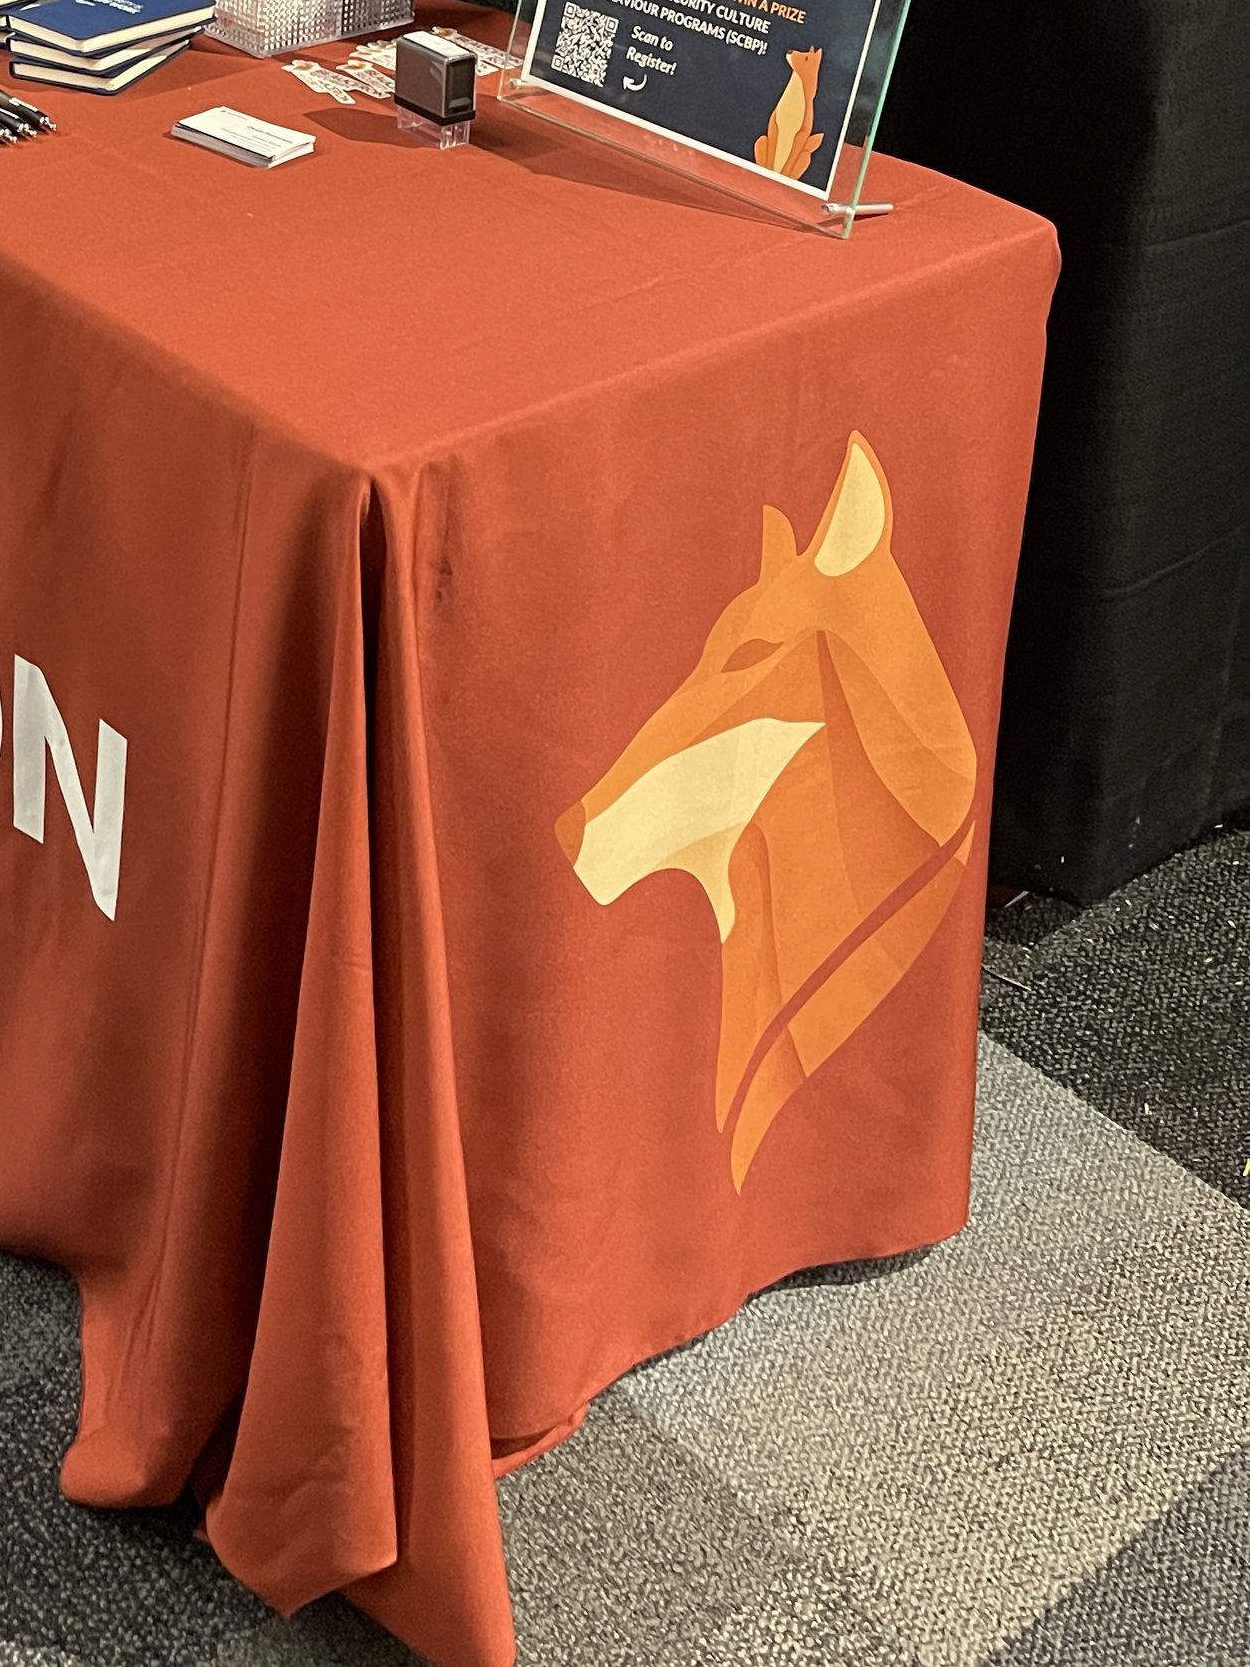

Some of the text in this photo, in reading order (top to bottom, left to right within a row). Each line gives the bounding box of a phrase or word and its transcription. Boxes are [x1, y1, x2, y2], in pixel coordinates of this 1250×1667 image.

[716, 5, 771, 34] CULTURE
[758, 0, 769, 13] A
[770, 2, 807, 24] PRIZE
[631, 25, 674, 51] Scan to
[659, 5, 727, 40] PROGRAMS
[725, 30, 768, 56] (SCBP)!
[626, 45, 678, 76] Register!
